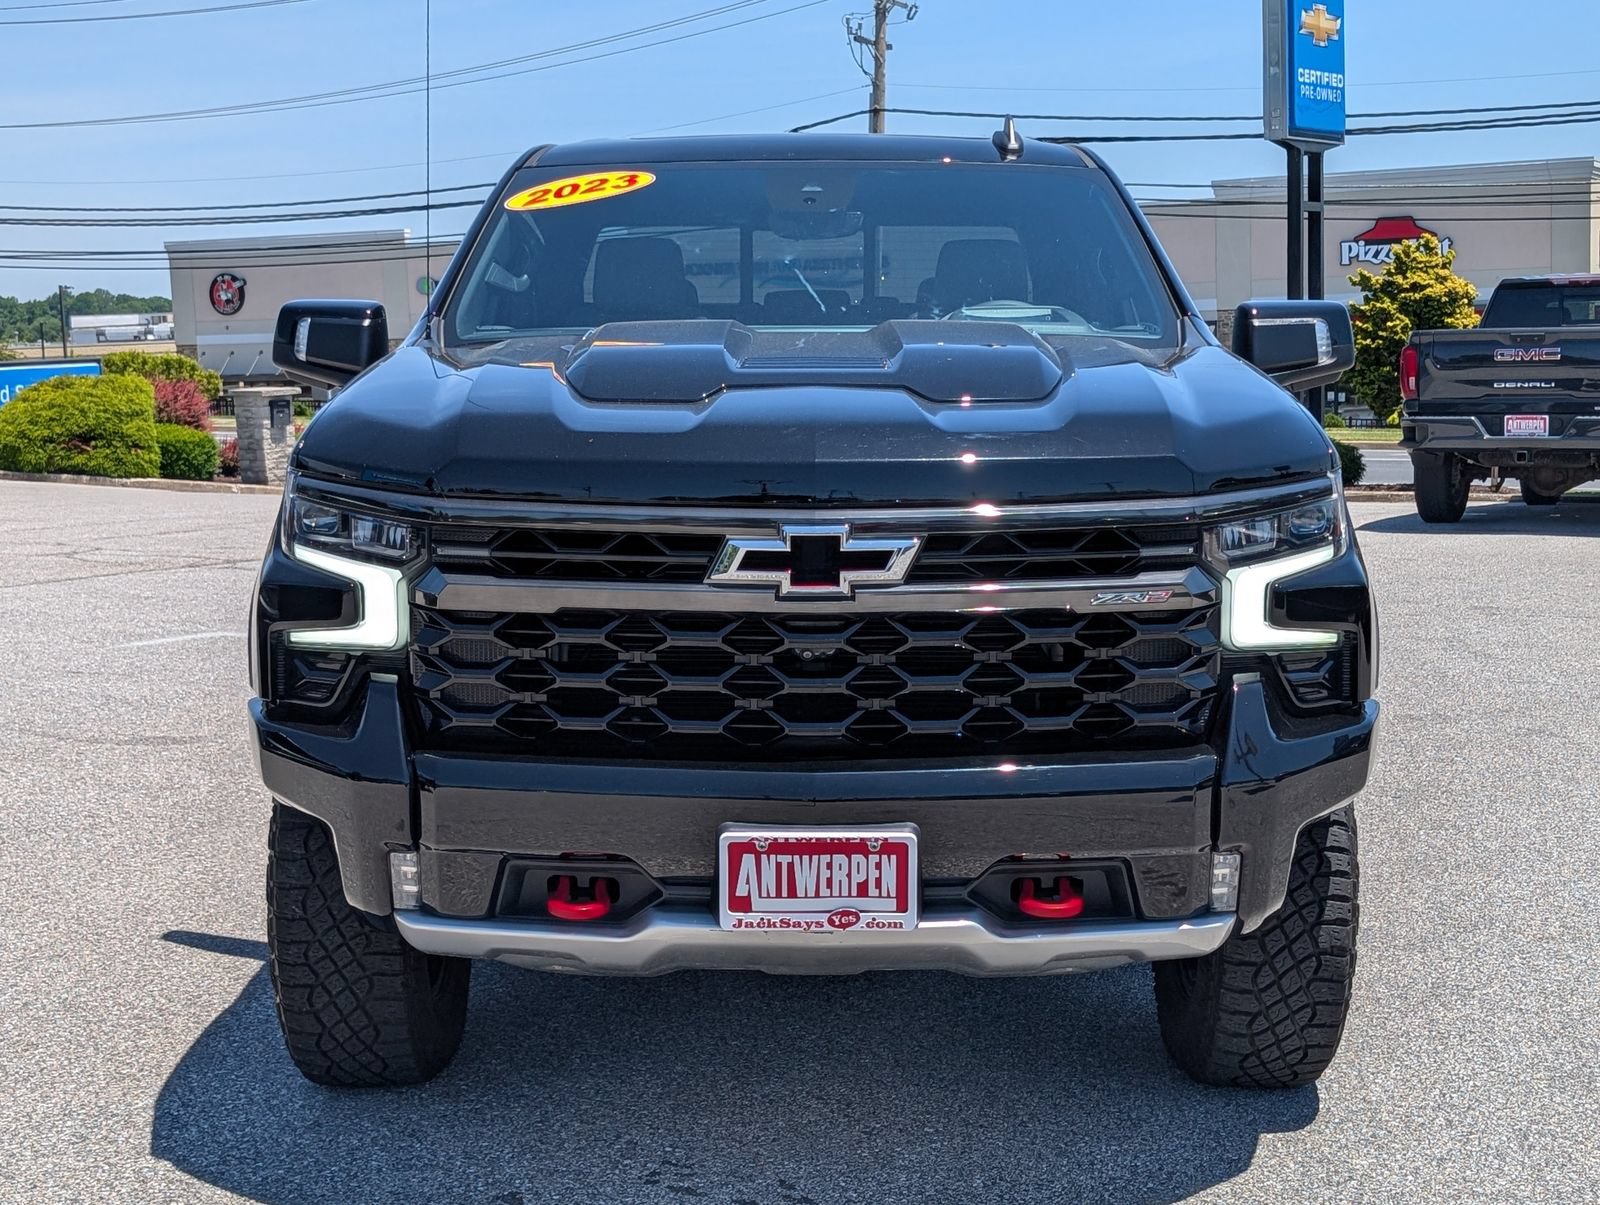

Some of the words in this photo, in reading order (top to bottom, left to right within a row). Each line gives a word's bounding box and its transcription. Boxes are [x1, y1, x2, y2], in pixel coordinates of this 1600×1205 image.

[1297, 67, 1344, 88] CERTIFIED
[1300, 85, 1342, 102] PRE-OWNED
[521, 173, 640, 207] 2023
[1341, 240, 1395, 265] Pizz
[1493, 347, 1561, 361] GMC
[735, 853, 897, 898] ANTWERPEN
